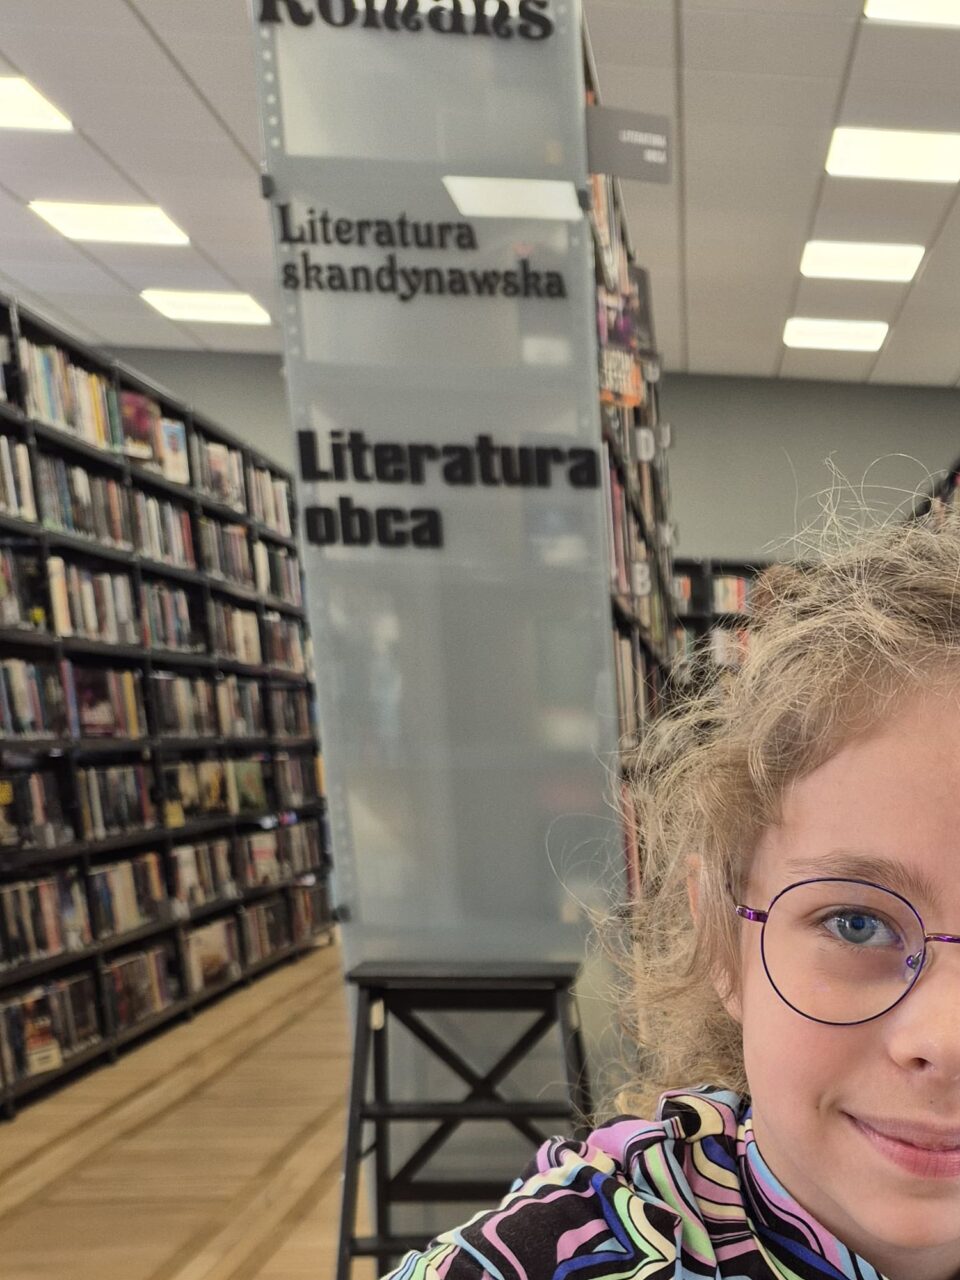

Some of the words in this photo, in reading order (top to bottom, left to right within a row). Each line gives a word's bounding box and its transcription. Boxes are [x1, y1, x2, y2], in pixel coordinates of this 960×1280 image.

[277, 204, 479, 251] Literatura
[281, 252, 568, 302] skandynawska
[297, 430, 601, 489] Literatura
[304, 497, 444, 550] obca
